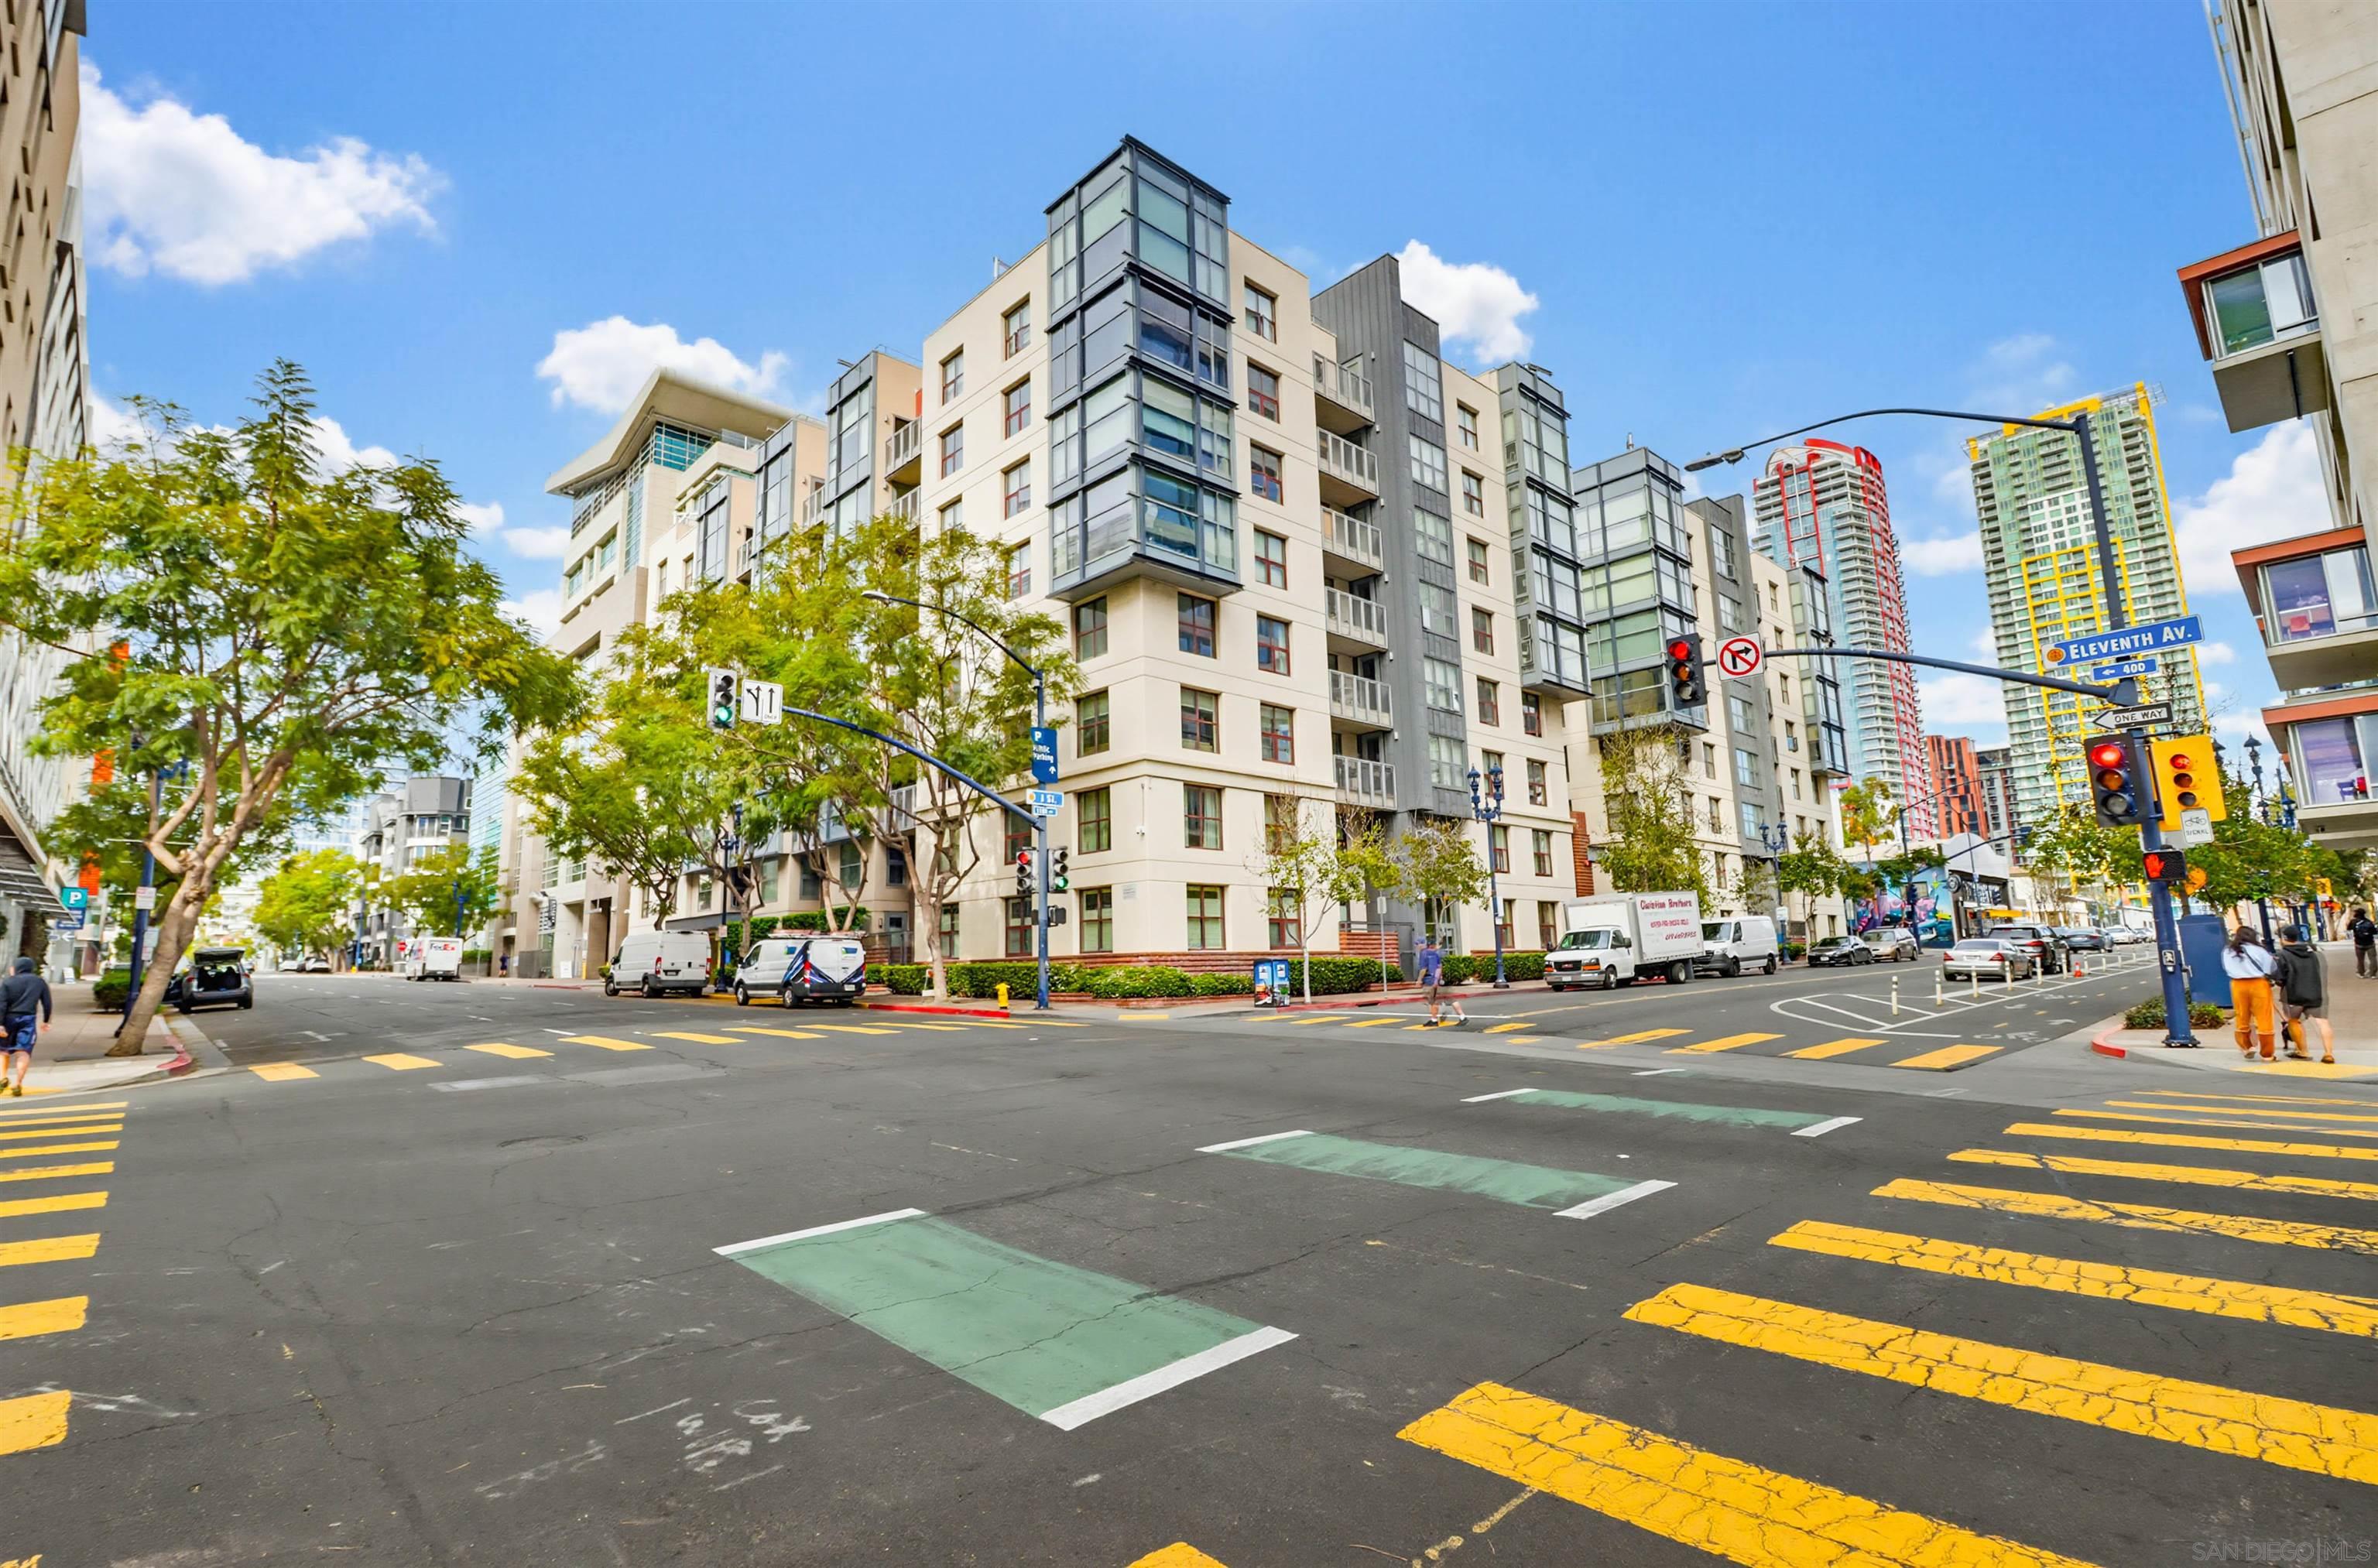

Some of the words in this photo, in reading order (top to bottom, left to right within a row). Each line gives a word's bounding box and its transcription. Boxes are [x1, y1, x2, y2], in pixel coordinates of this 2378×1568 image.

[2069, 632, 2154, 659] ELEVENTH
[2162, 625, 2193, 643] AV.
[2123, 662, 2146, 674] 400
[2114, 712, 2137, 723] ONE
[2140, 709, 2164, 720] WAY
[1034, 731, 1042, 741] P
[69, 892, 82, 904] P
